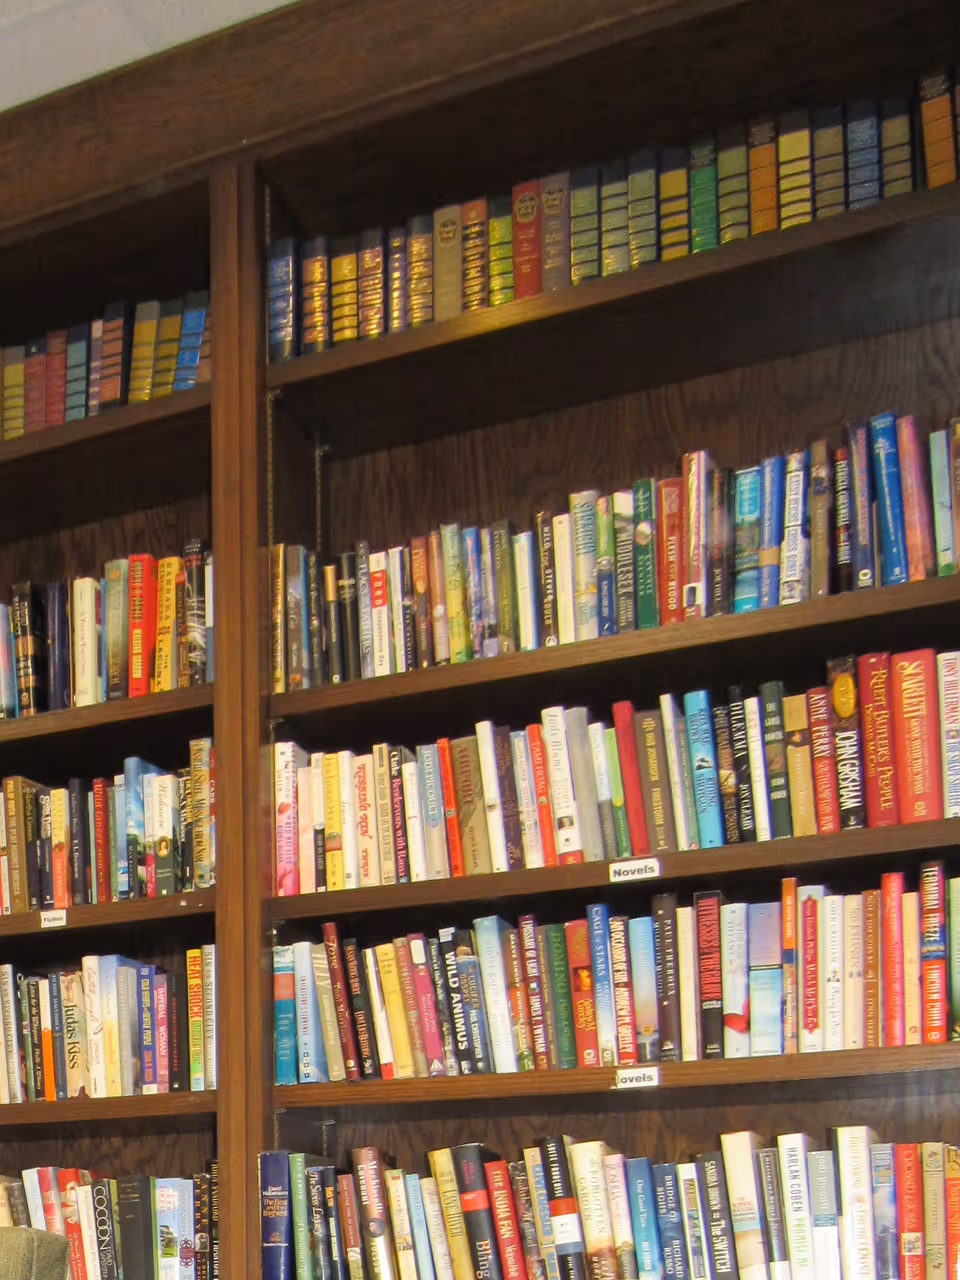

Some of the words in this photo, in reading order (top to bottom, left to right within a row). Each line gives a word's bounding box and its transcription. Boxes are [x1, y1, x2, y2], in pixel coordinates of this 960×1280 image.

[616, 532, 634, 594] MIDDLESEX
[667, 536, 676, 563] FLESH
[164, 561, 174, 622] BARBARA
[358, 563, 371, 593] FLAGS
[373, 572, 386, 607] FORD
[545, 568, 554, 599] STEVEN
[601, 580, 611, 618] KINGSBURY
[668, 580, 678, 611] BLOOD
[360, 609, 374, 655] FATHERS
[155, 639, 164, 687] LACUNA
[942, 658, 956, 678] TONY
[870, 668, 888, 706] RHETT
[896, 659, 928, 719] SCARLETT
[943, 679, 960, 725] HILLERMAN
[699, 709, 709, 728] RITA
[809, 693, 829, 723] ANNE
[545, 713, 561, 738] Judy
[645, 732, 654, 747] IRIS
[689, 713, 702, 745] BROWN
[702, 729, 710, 745] MAE
[729, 701, 749, 759] DILEMMA
[875, 710, 892, 762] BUTLER'S
[530, 742, 544, 764] TAMI
[550, 740, 566, 771] Blume
[813, 726, 832, 759] PERRY
[835, 730, 857, 759] JOHN
[390, 751, 402, 777] Clarke
[455, 746, 475, 806] AIRPORT
[534, 763, 548, 794] HOAG
[646, 747, 659, 782] JOHANSEN
[94, 783, 104, 809] Wild
[695, 774, 709, 814] SHOTGUN
[705, 777, 717, 807] RIDING
[816, 760, 832, 814] SOUTHAMPTON
[838, 759, 862, 811] GRISHAM
[879, 765, 894, 811] PEOPLE
[391, 778, 405, 830] Rendezvous
[651, 787, 665, 825] FIRESTORM
[740, 799, 754, 831] CLEARY
[95, 809, 105, 845] Ginger
[821, 815, 834, 831] ROW
[395, 831, 406, 851] with
[506, 841, 517, 867] VILLA
[397, 851, 409, 878] Rama
[613, 864, 655, 879] Novels
[922, 867, 941, 911] TERMINAL
[522, 920, 536, 950] EMISSARY
[591, 907, 603, 936] CAGE
[664, 919, 674, 946] PAUL
[924, 913, 942, 943] FREEZE
[204, 951, 214, 967] SIN
[509, 934, 519, 959] MAEVE
[596, 944, 608, 978] STARS
[611, 931, 626, 962] OCCASION
[848, 924, 862, 969] JOHANSEN
[0, 970, 11, 986] SIN
[188, 956, 202, 982] HEAT
[444, 951, 460, 988] WILD
[527, 958, 540, 978] LIGHT
[550, 933, 568, 993] DOMINO
[666, 948, 677, 997] THEROUX
[806, 963, 818, 986] Match
[332, 982, 343, 1002] Toni
[460, 974, 471, 1004] GOSPEL
[468, 974, 480, 1010] LUCIFER
[925, 964, 942, 1001] LINCOLN
[157, 987, 167, 1019] IMPERIAL
[189, 983, 203, 1019] SHOCK
[205, 981, 215, 1017] SECOND
[529, 995, 543, 1015] JAMES
[616, 987, 631, 1016] ANDREW
[2, 999, 13, 1034] SECOND
[63, 1000, 80, 1040] Judas
[206, 1018, 215, 1040] CITY
[335, 1004, 348, 1043] Morrison
[451, 993, 469, 1051] ANIMUS
[926, 1002, 942, 1028] CHILD
[158, 1025, 167, 1057] WOMAN
[191, 1020, 202, 1049] ROBERT
[532, 1024, 547, 1053] TWYMAN
[620, 1023, 635, 1054] GREELEY
[68, 1040, 82, 1070] Kiss
[309, 1172, 318, 1186] The
[492, 1169, 502, 1187] THE
[704, 1160, 718, 1187] SANDRA
[785, 1147, 801, 1181] HARLAN
[311, 1186, 322, 1207] Swiss
[358, 1164, 370, 1206] Covenant
[370, 1160, 384, 1214] Machiavelli
[580, 1176, 593, 1221] GARDEN
[635, 1180, 645, 1193] One
[664, 1175, 674, 1208] BRIDGE
[707, 1187, 721, 1210] BROWN
[790, 1183, 804, 1213] COBEN
[194, 1179, 202, 1231] PERRY
[200, 1183, 209, 1226] ANNE
[493, 1189, 511, 1217] INDIA
[591, 1170, 608, 1235] FORGOTTEN
[637, 1194, 647, 1213] Good
[655, 1187, 667, 1216] SIGHS
[667, 1210, 678, 1223] OF
[94, 1185, 112, 1251] COCOON
[311, 1207, 324, 1236] Legacy
[500, 1219, 514, 1239] FAN
[639, 1213, 648, 1228] Turn
[710, 1218, 725, 1237] The
[196, 1253, 202, 1264] OF
[475, 1239, 492, 1280] Bling
[662, 1247, 674, 1275] RUSSO
[671, 1239, 685, 1279] RICHARD
[713, 1236, 731, 1273] SWITCH
